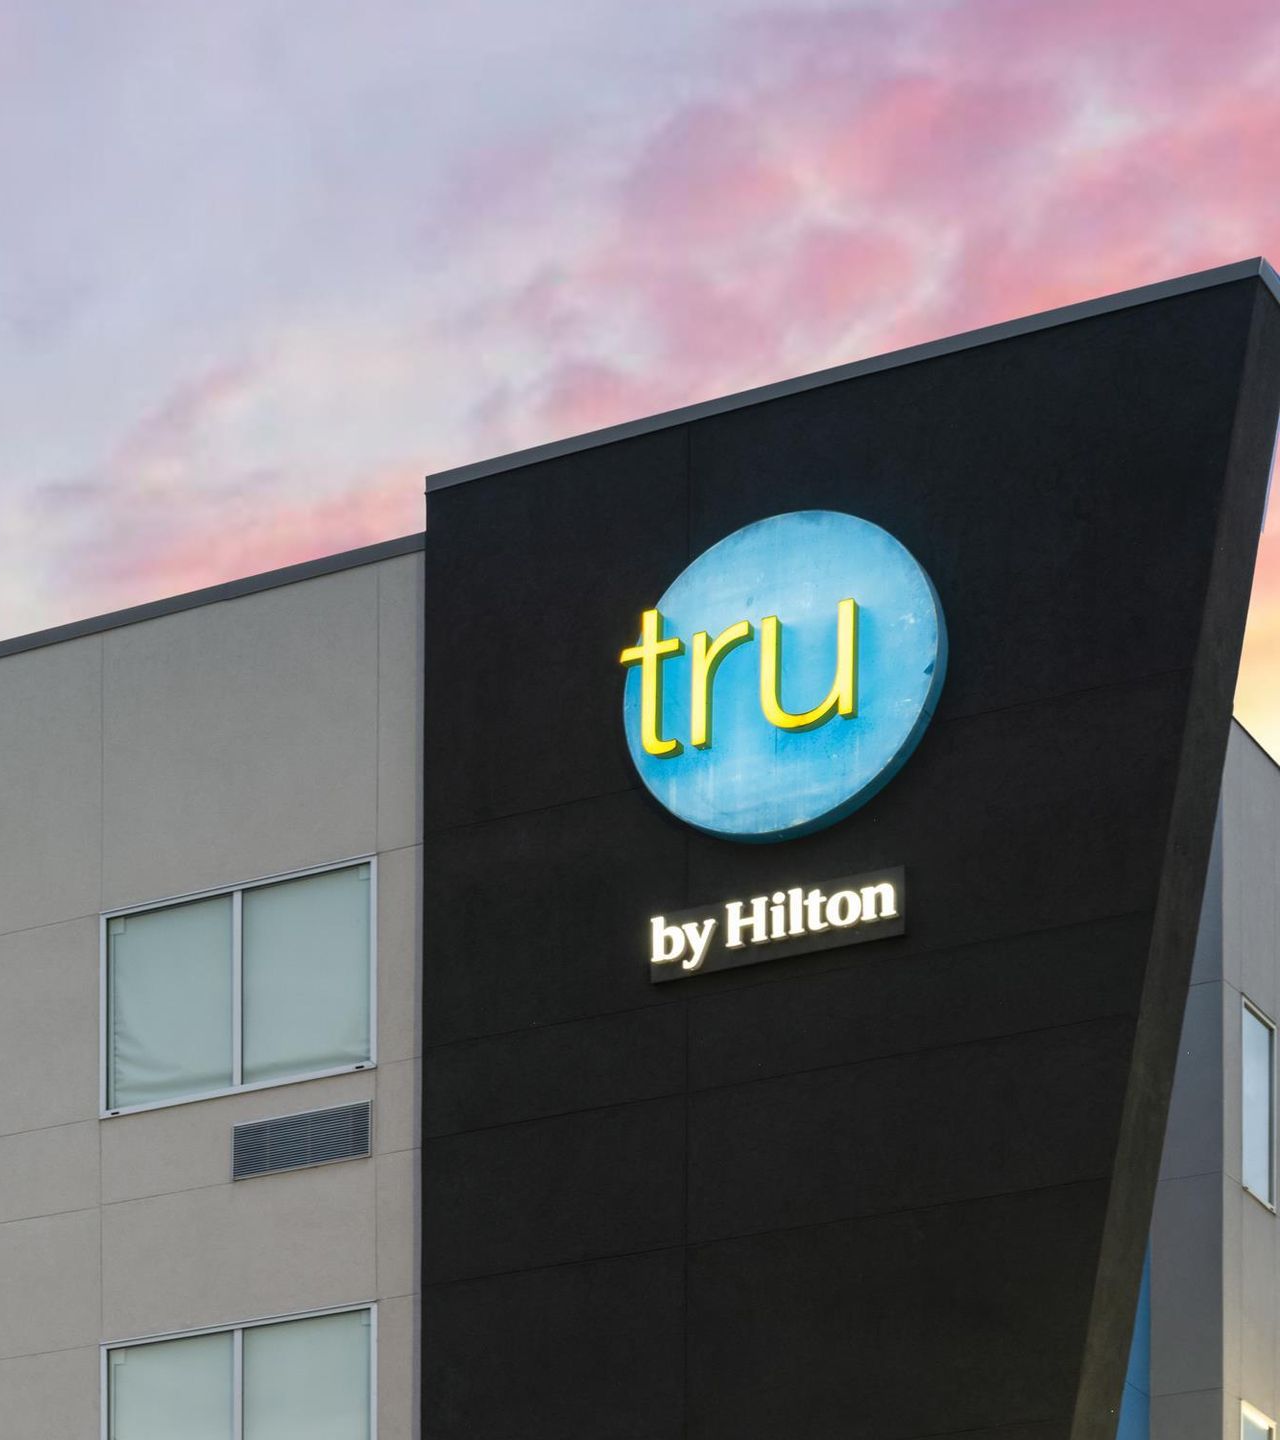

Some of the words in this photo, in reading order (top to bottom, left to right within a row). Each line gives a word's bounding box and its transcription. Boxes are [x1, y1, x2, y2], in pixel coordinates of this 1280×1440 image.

[620, 598, 859, 758] tru
[650, 916, 717, 970] by
[725, 880, 900, 949] Hilton
